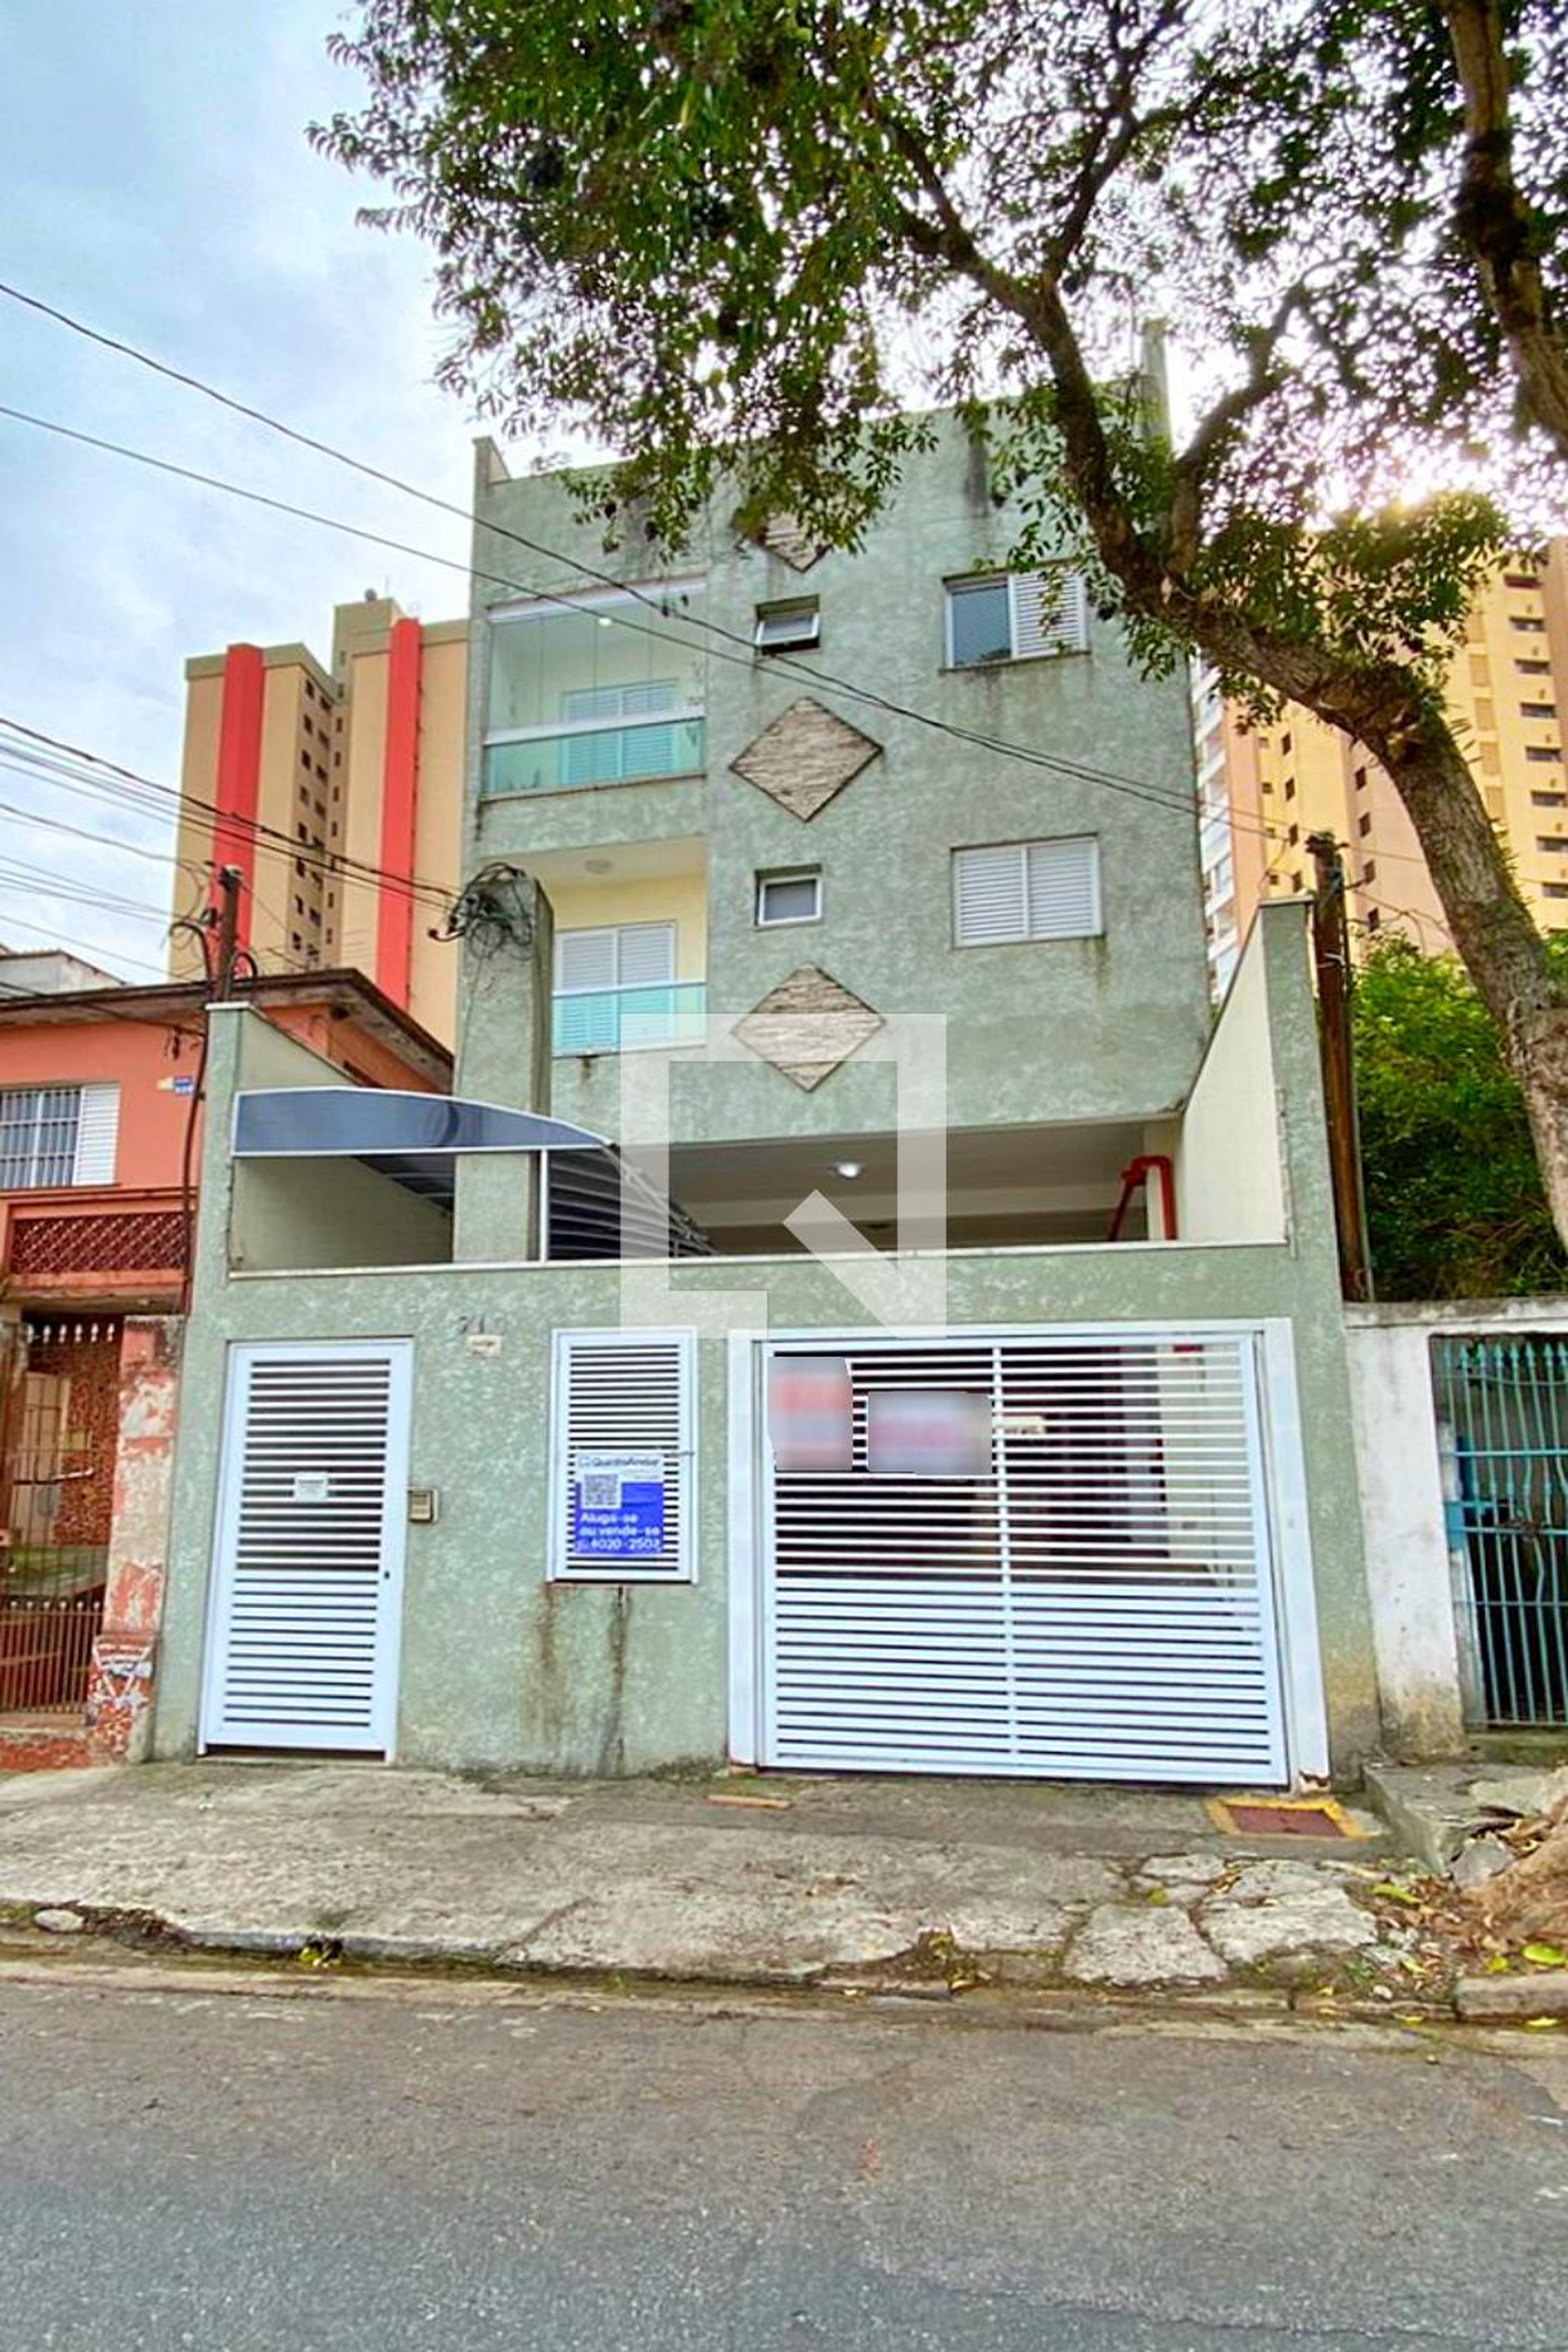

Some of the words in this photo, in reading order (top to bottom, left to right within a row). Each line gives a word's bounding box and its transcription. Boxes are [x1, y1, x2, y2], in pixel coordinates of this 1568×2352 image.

[580, 1512, 638, 1525] Aluga-se
[580, 1527, 596, 1536] ou
[599, 1525, 660, 1536] vende-se
